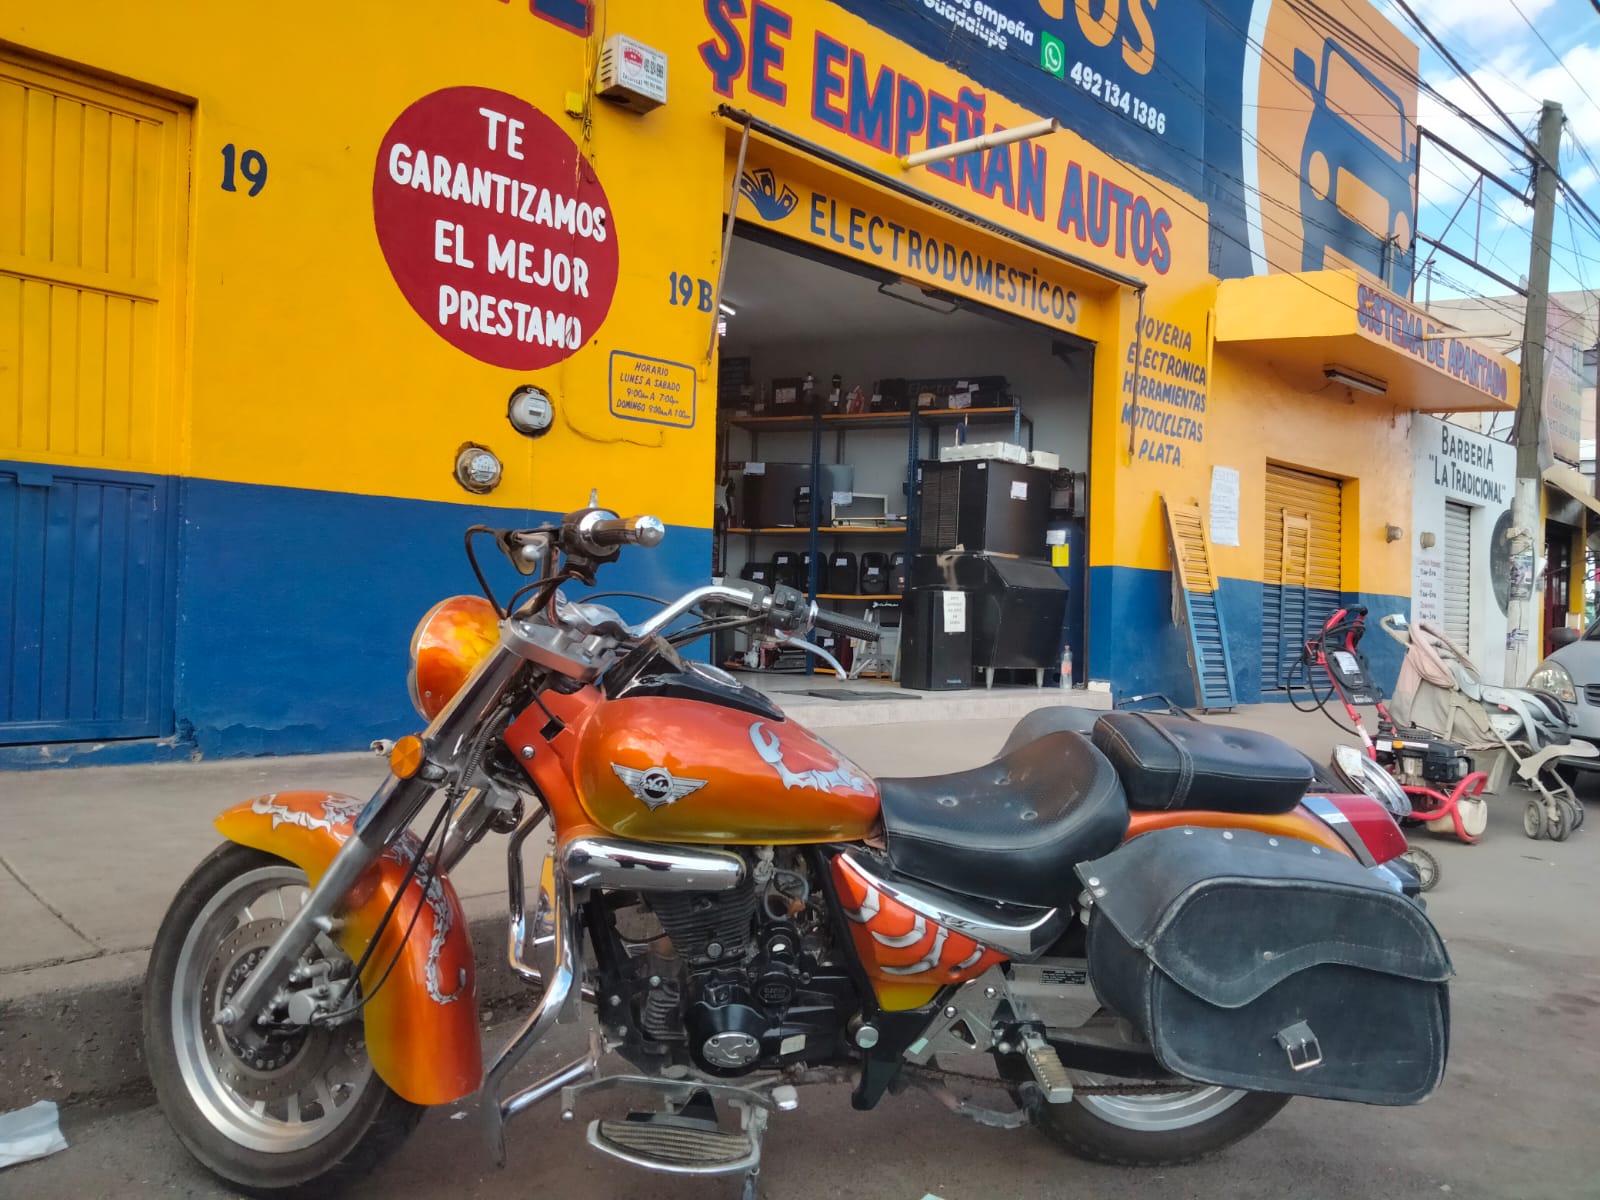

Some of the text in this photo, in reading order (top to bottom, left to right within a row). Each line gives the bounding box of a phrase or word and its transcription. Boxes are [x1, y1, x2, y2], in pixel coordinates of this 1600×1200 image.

[973, 0, 1034, 46] empeña
[1070, 61, 1166, 135] 492 134 1386
[479, 107, 525, 160] TE
[811, 29, 1047, 221] EMPEÑAN
[1057, 160, 1172, 276] AUTOS
[221, 143, 268, 197] 19
[389, 143, 607, 242] GARANTIZAMOS
[434, 219, 589, 298] EL MEJOR
[669, 271, 713, 313] 19 B
[438, 285, 581, 350] PRESTAMO
[1135, 313, 1192, 353] JOYERIA
[635, 361, 669, 377] HORARIO
[1426, 323, 1445, 370] DE
[616, 398, 646, 412] DOMINGO
[620, 372, 680, 392] LUNES A SABADO
[1121, 402, 1203, 443] MOTOCICLETAS
[1138, 438, 1181, 466] PLATA
[1441, 425, 1494, 472] BARBERIA
